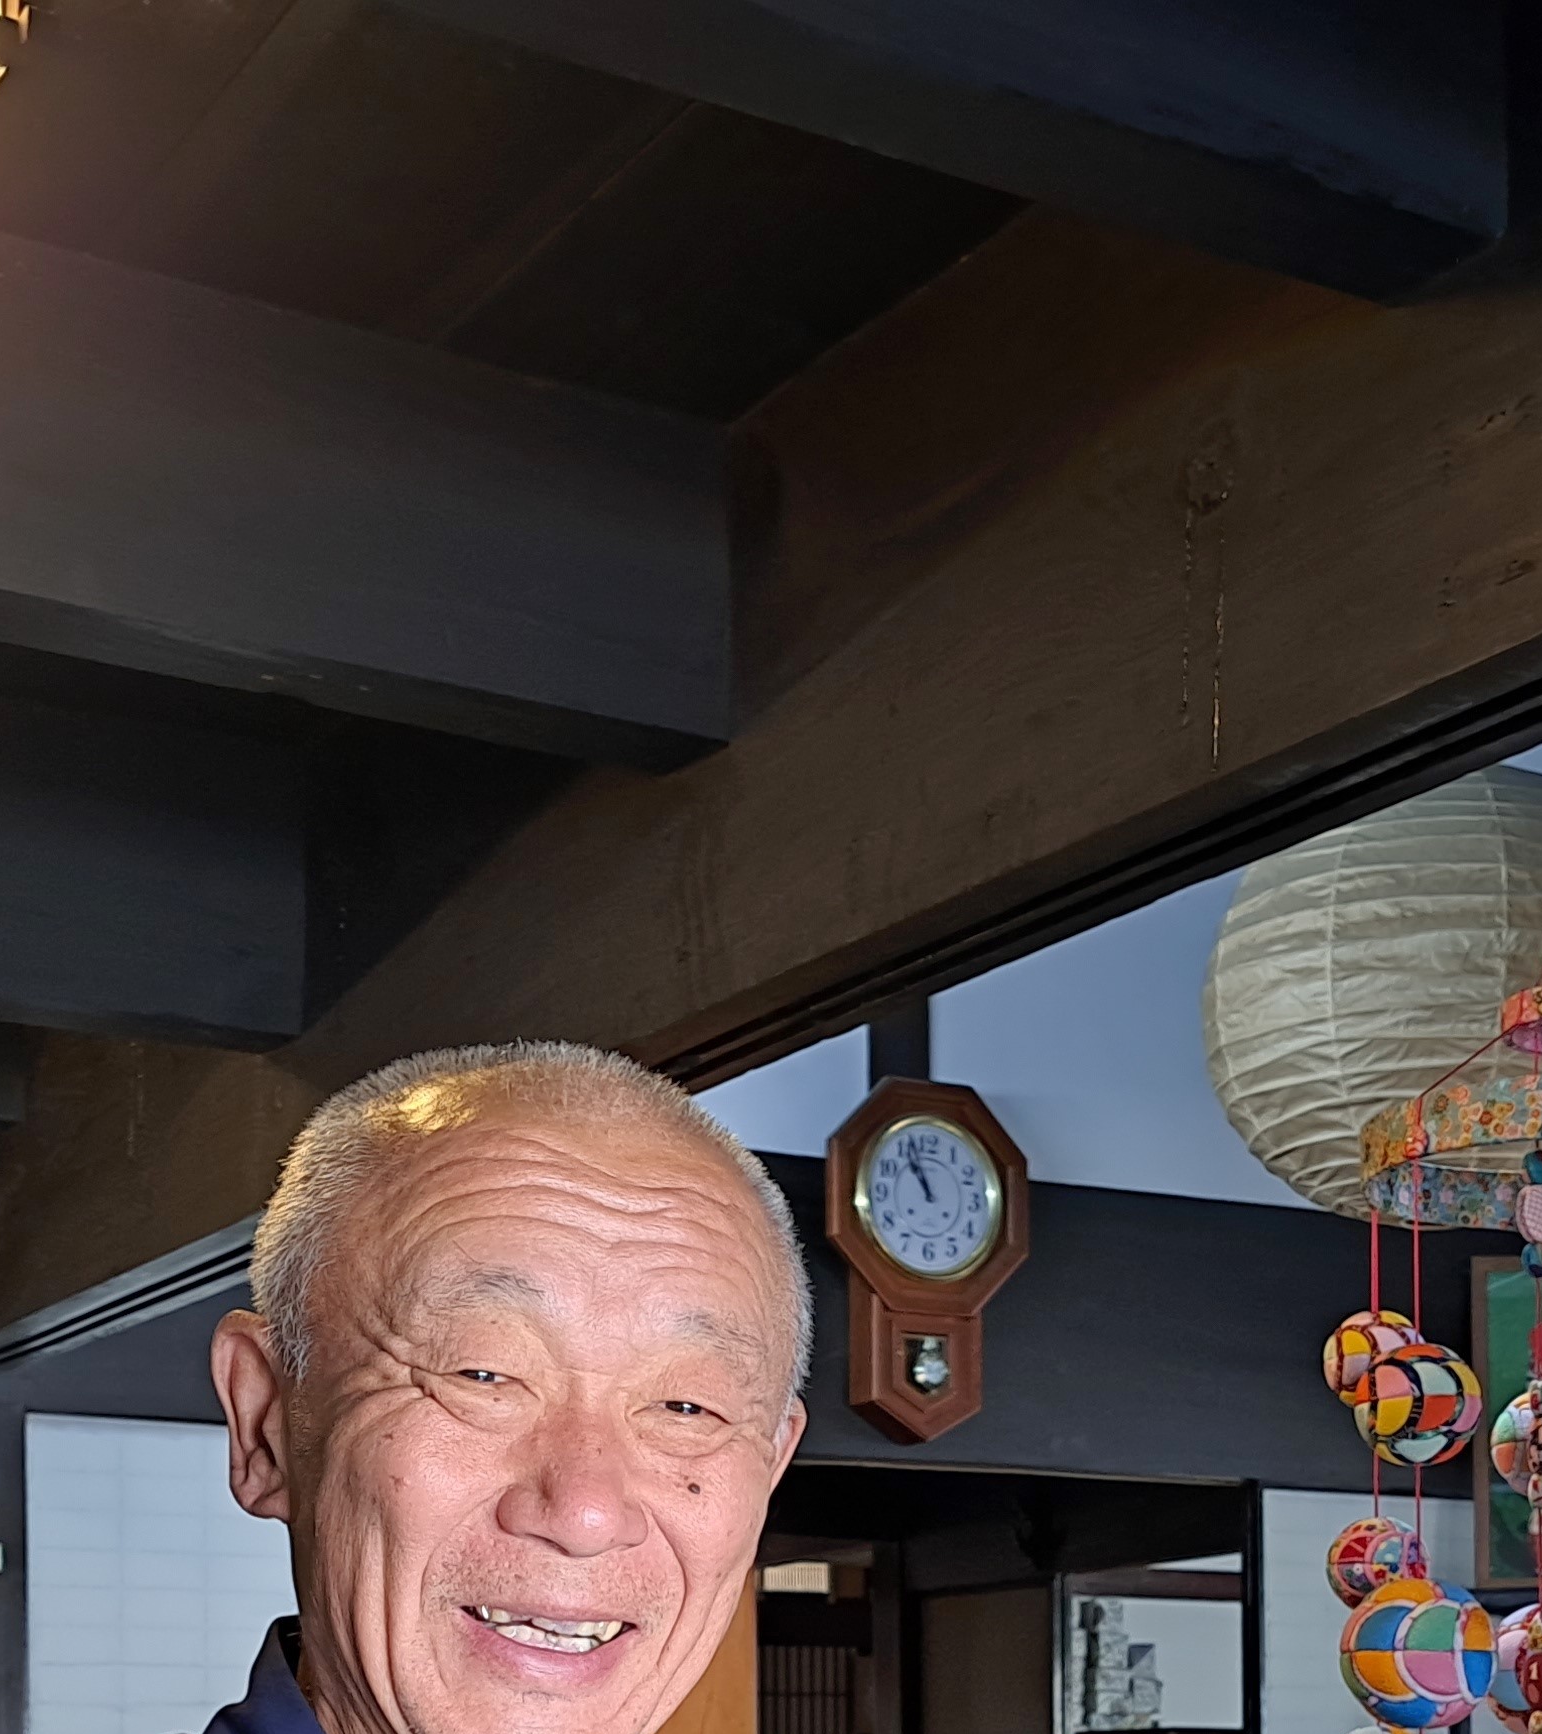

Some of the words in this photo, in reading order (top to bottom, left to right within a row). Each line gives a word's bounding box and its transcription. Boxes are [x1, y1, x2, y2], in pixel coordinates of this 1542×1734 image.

[920, 1134, 939, 1154] 12
[950, 1146, 957, 1165] 1
[880, 1159, 897, 1177] 10
[962, 1164, 975, 1186] 2
[875, 1182, 888, 1202] 9
[967, 1192, 980, 1213] 3
[882, 1210, 895, 1230] 8
[961, 1220, 975, 1239] 4
[900, 1232, 911, 1252] 7
[922, 1241, 936, 1262] 6
[945, 1236, 958, 1258] 5
